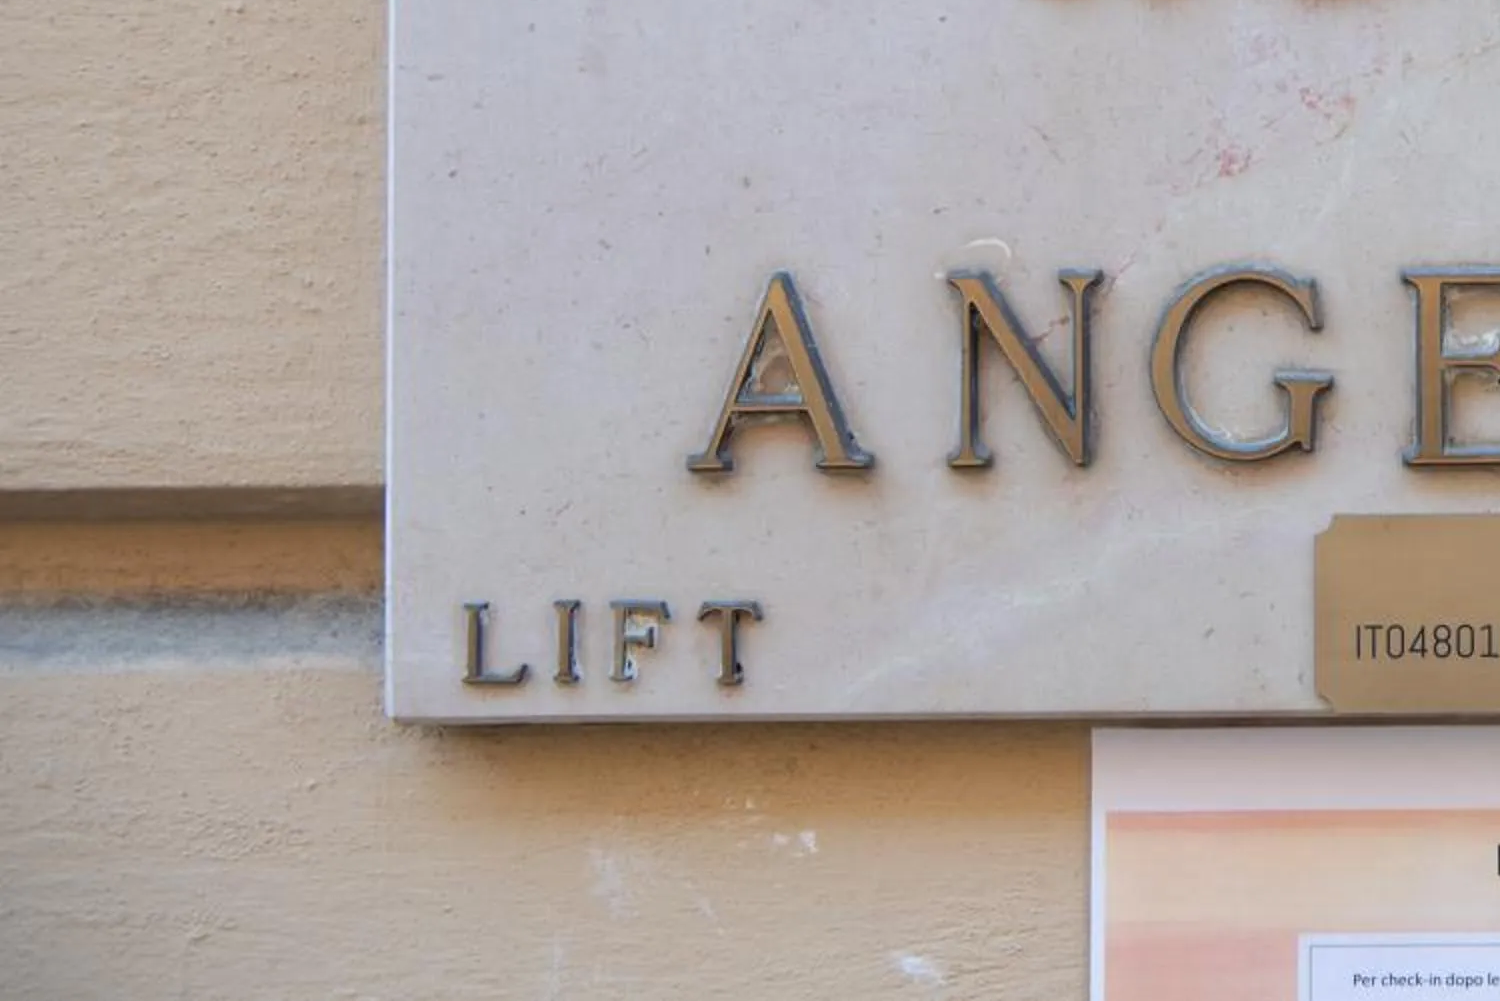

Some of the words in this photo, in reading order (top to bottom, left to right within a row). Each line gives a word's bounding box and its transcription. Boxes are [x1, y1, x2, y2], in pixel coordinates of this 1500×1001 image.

[461, 599, 764, 685] LIFT
[1353, 973, 1377, 987] Per
[1381, 972, 1441, 987] check-in
[1445, 972, 1483, 990] dopo
[1487, 972, 1500, 986] le
